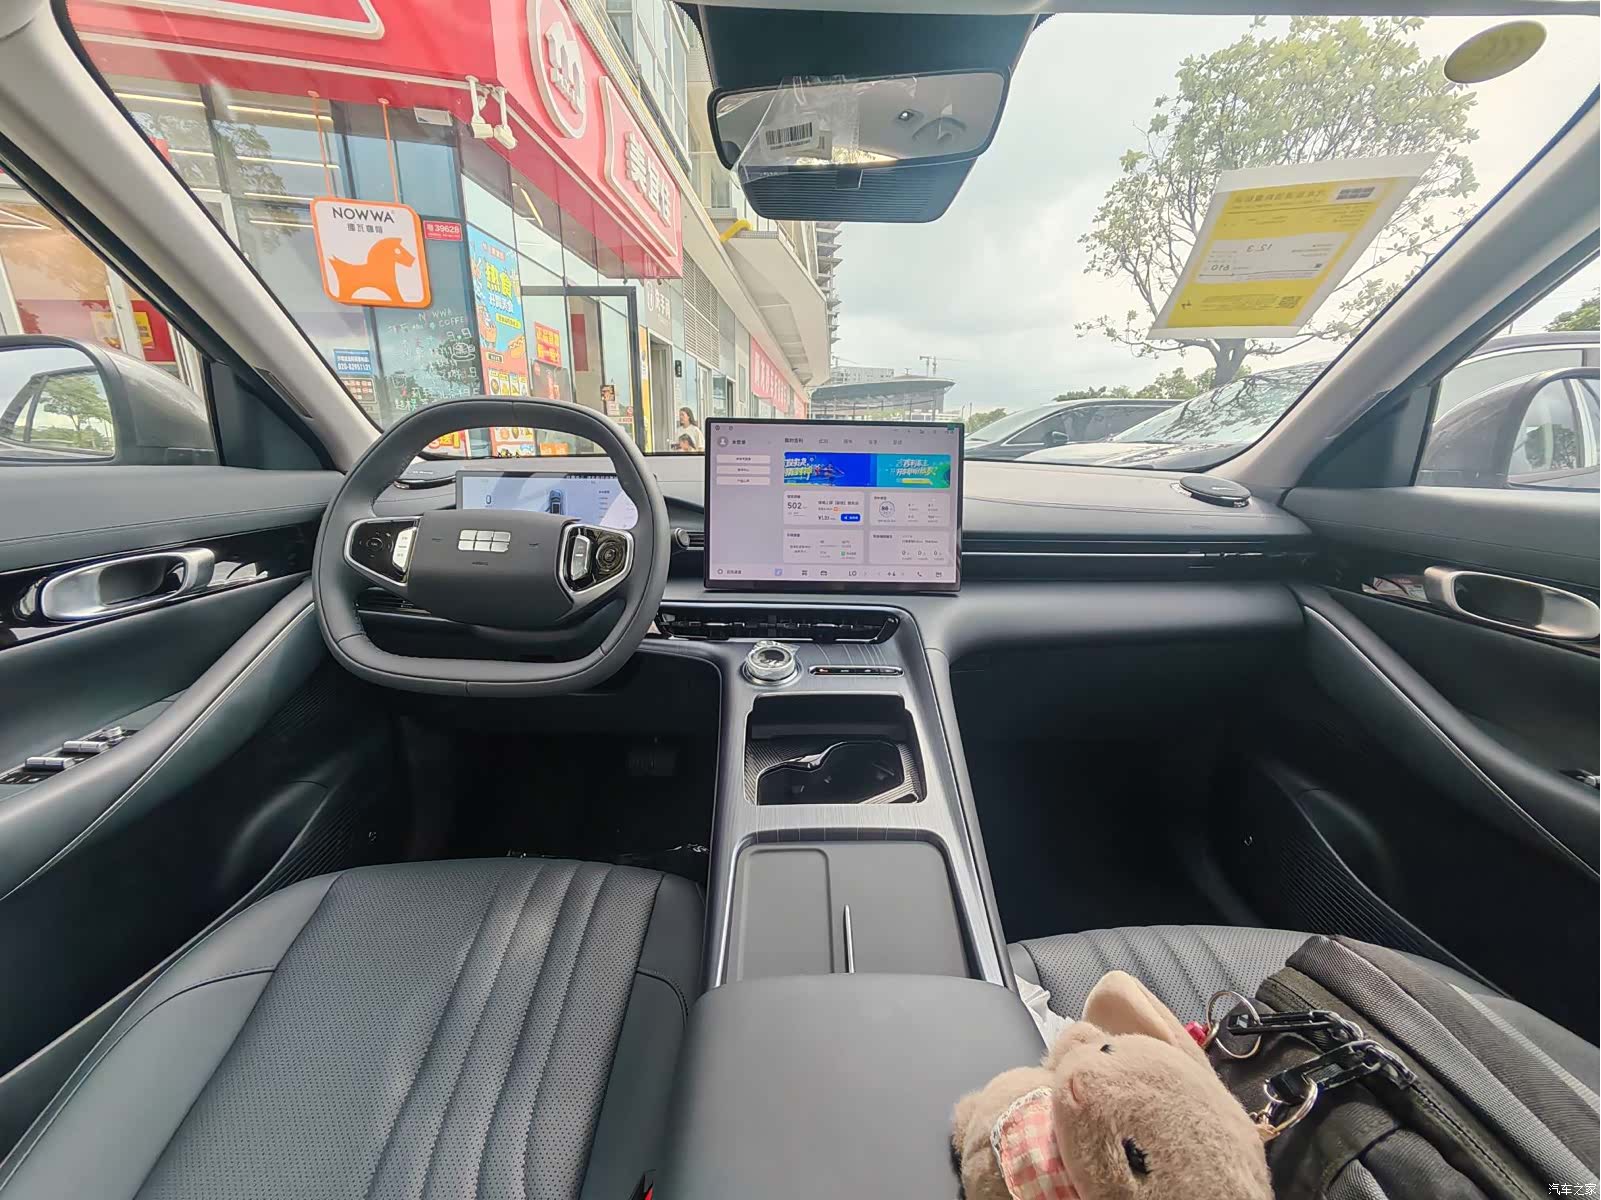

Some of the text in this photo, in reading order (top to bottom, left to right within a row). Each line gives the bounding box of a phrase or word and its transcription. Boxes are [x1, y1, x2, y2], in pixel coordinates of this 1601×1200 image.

[624, 131, 671, 228] 美宜佳
[332, 206, 395, 224] NOWWA
[787, 502, 802, 510] 502
